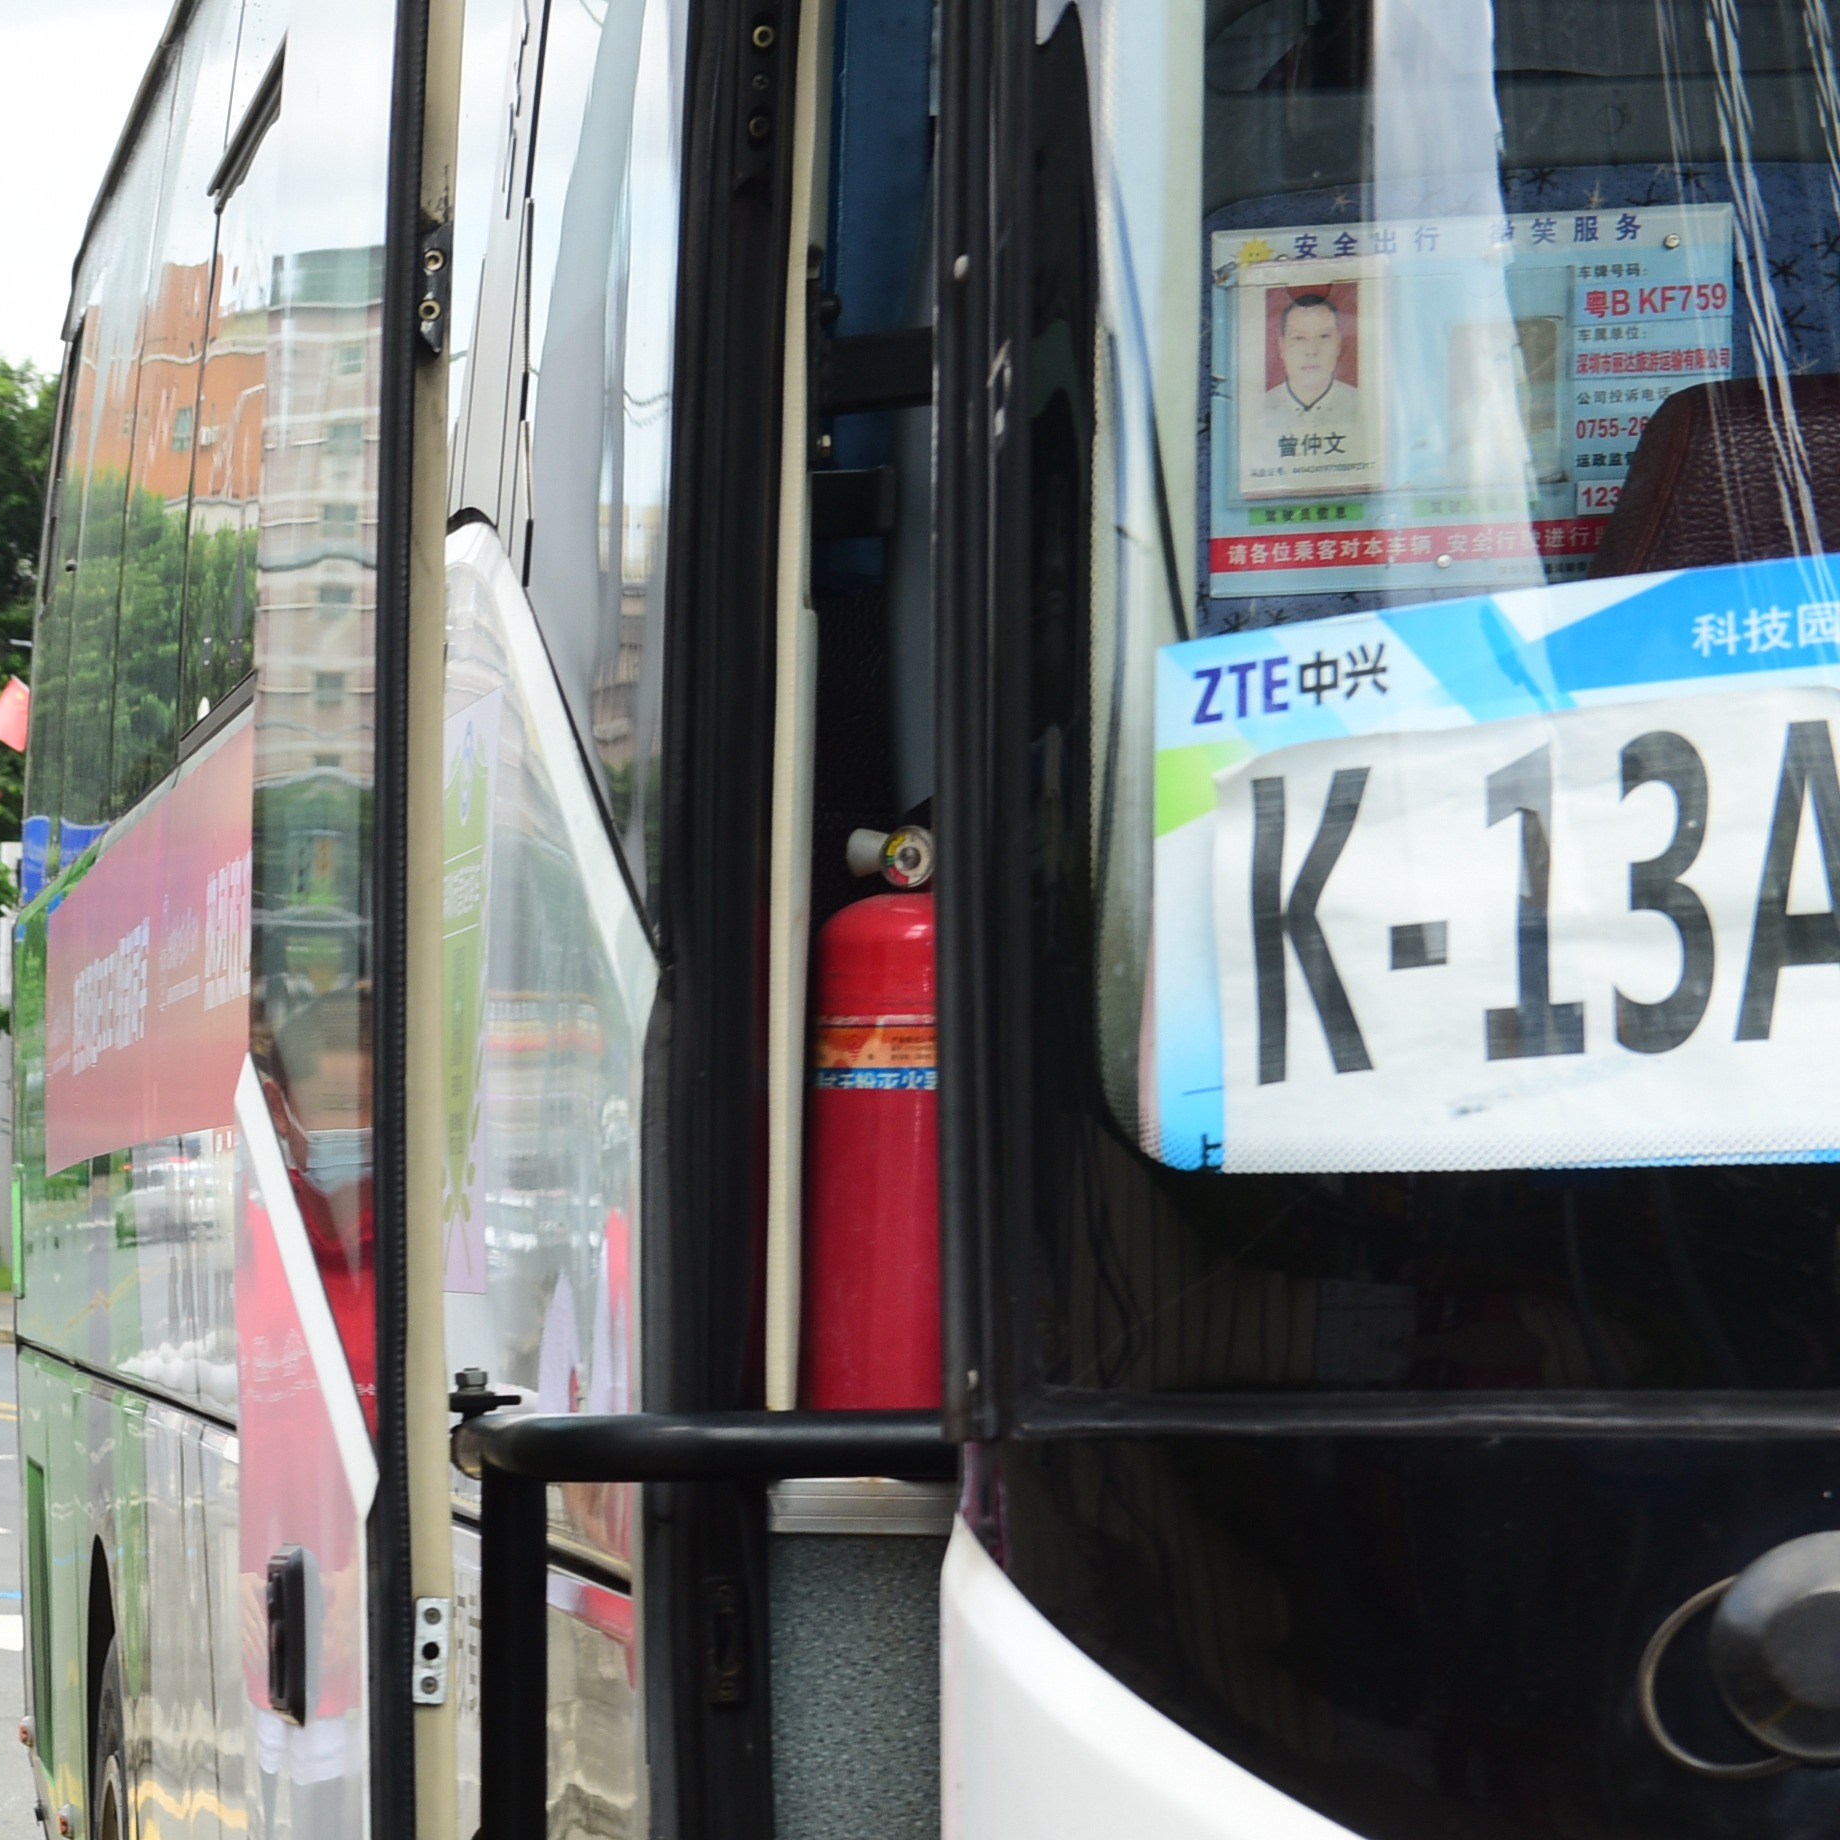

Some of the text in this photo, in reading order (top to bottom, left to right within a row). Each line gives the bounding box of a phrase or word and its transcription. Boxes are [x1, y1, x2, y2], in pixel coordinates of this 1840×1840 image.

[1294, 226, 1440, 260] 安全出行
[1584, 282, 1727, 318] 粤B KF759
[1277, 432, 1347, 458] 曾仲文
[1227, 533, 1433, 566] 请各位乘客对本车辆
[1691, 602, 1840, 658] 科技园
[1250, 719, 1840, 1087] K-13A
